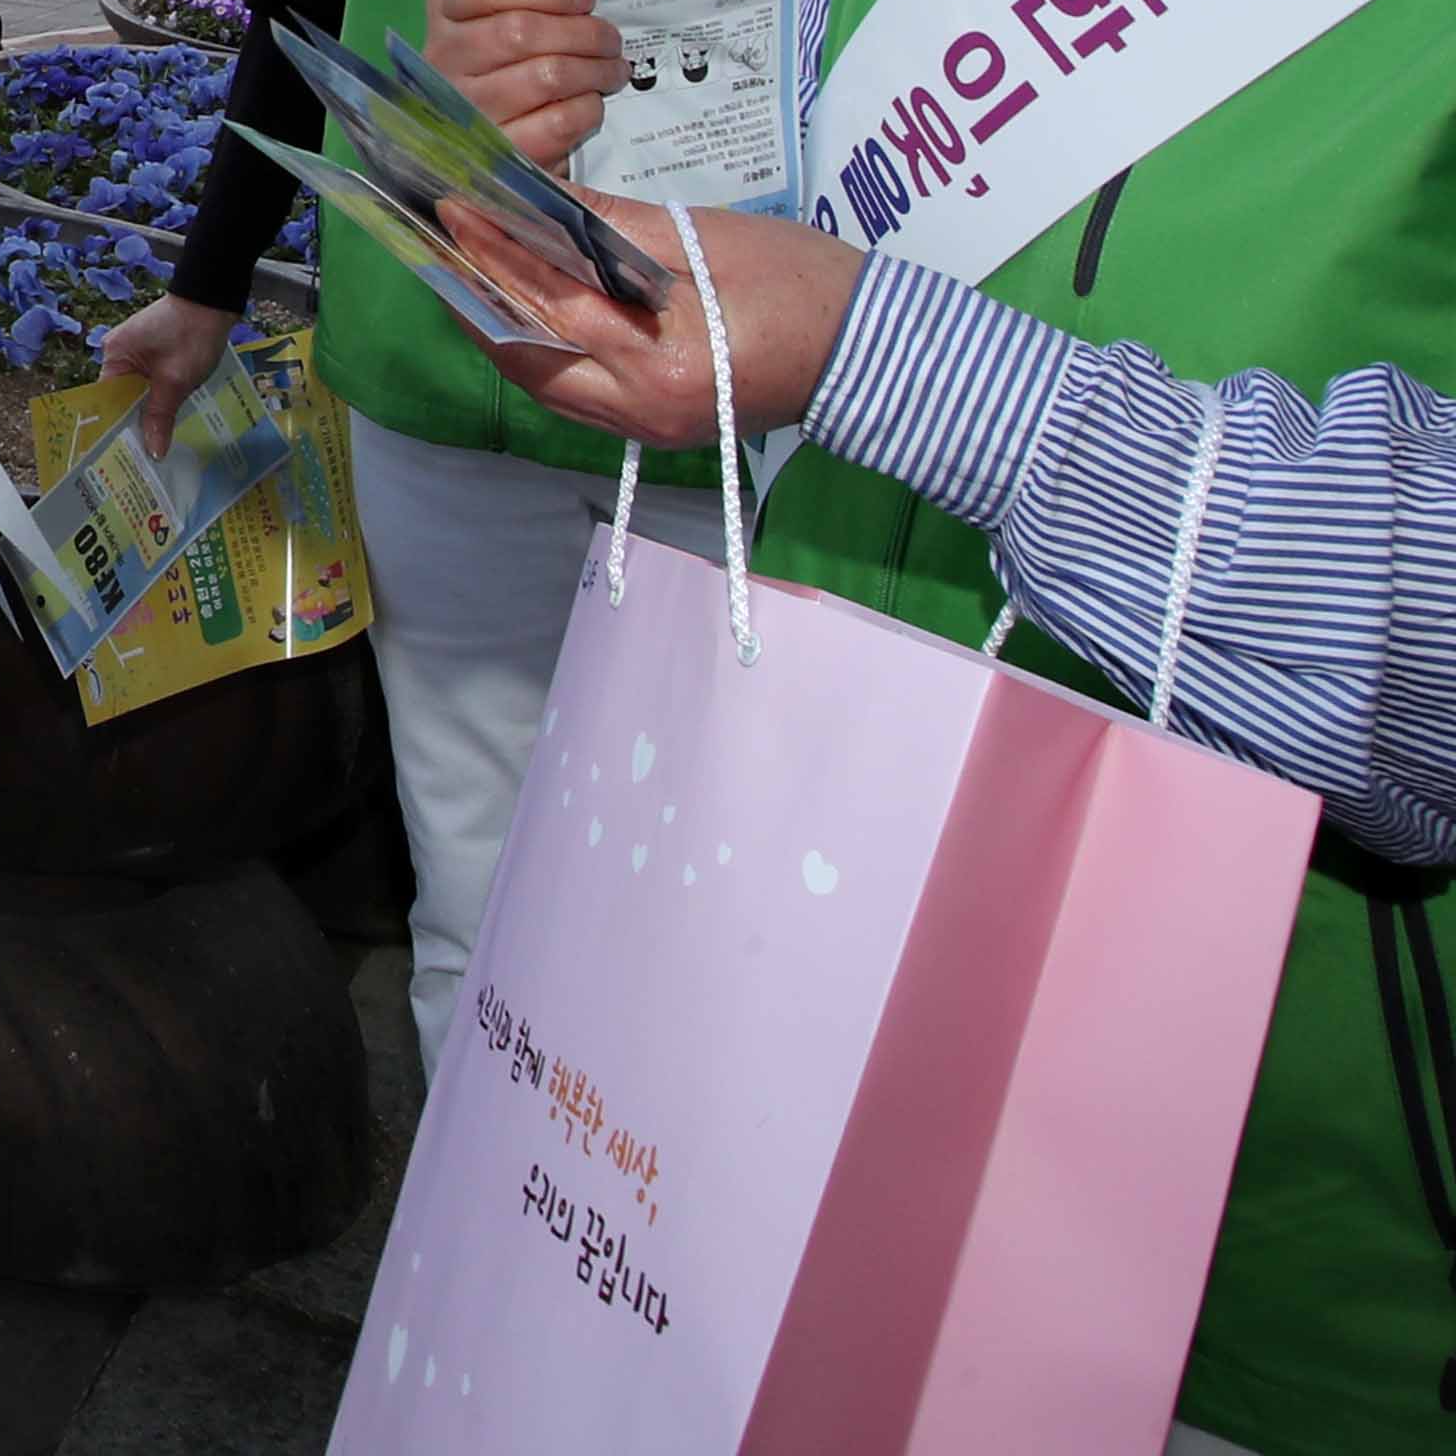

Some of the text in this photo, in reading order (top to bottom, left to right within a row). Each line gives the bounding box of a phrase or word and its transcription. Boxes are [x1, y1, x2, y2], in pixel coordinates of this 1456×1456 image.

[69, 522, 127, 616] KF80
[510, 1017, 546, 1090] 함께
[548, 1055, 604, 1159] 행복한
[522, 1163, 670, 1335] 우리의 꿈입니다
